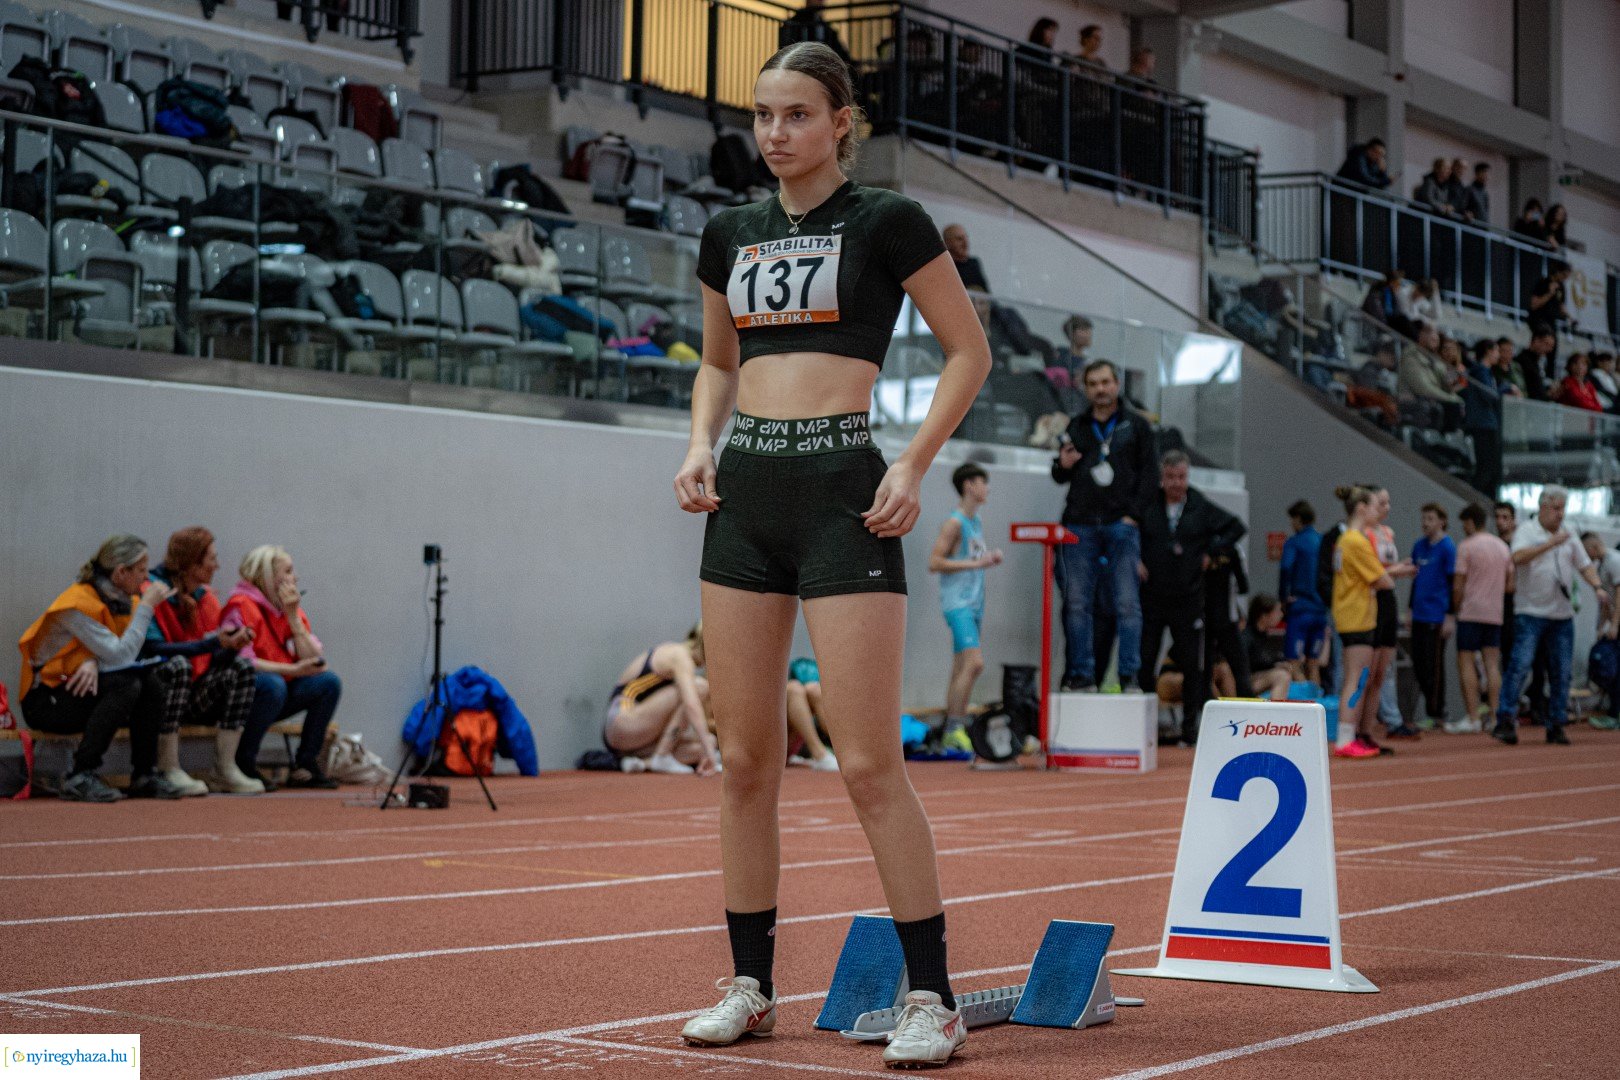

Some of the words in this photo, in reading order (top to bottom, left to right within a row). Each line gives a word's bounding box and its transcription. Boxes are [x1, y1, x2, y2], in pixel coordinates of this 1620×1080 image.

[759, 238, 834, 256] STABILITA
[740, 256, 825, 313] 137
[749, 313, 813, 326] ATLETIKA
[735, 415, 755, 430] MP
[796, 418, 830, 434] MP
[756, 437, 788, 452] MP
[841, 431, 869, 446] MP
[1243, 721, 1304, 738] polanik
[1201, 751, 1308, 919] 2
